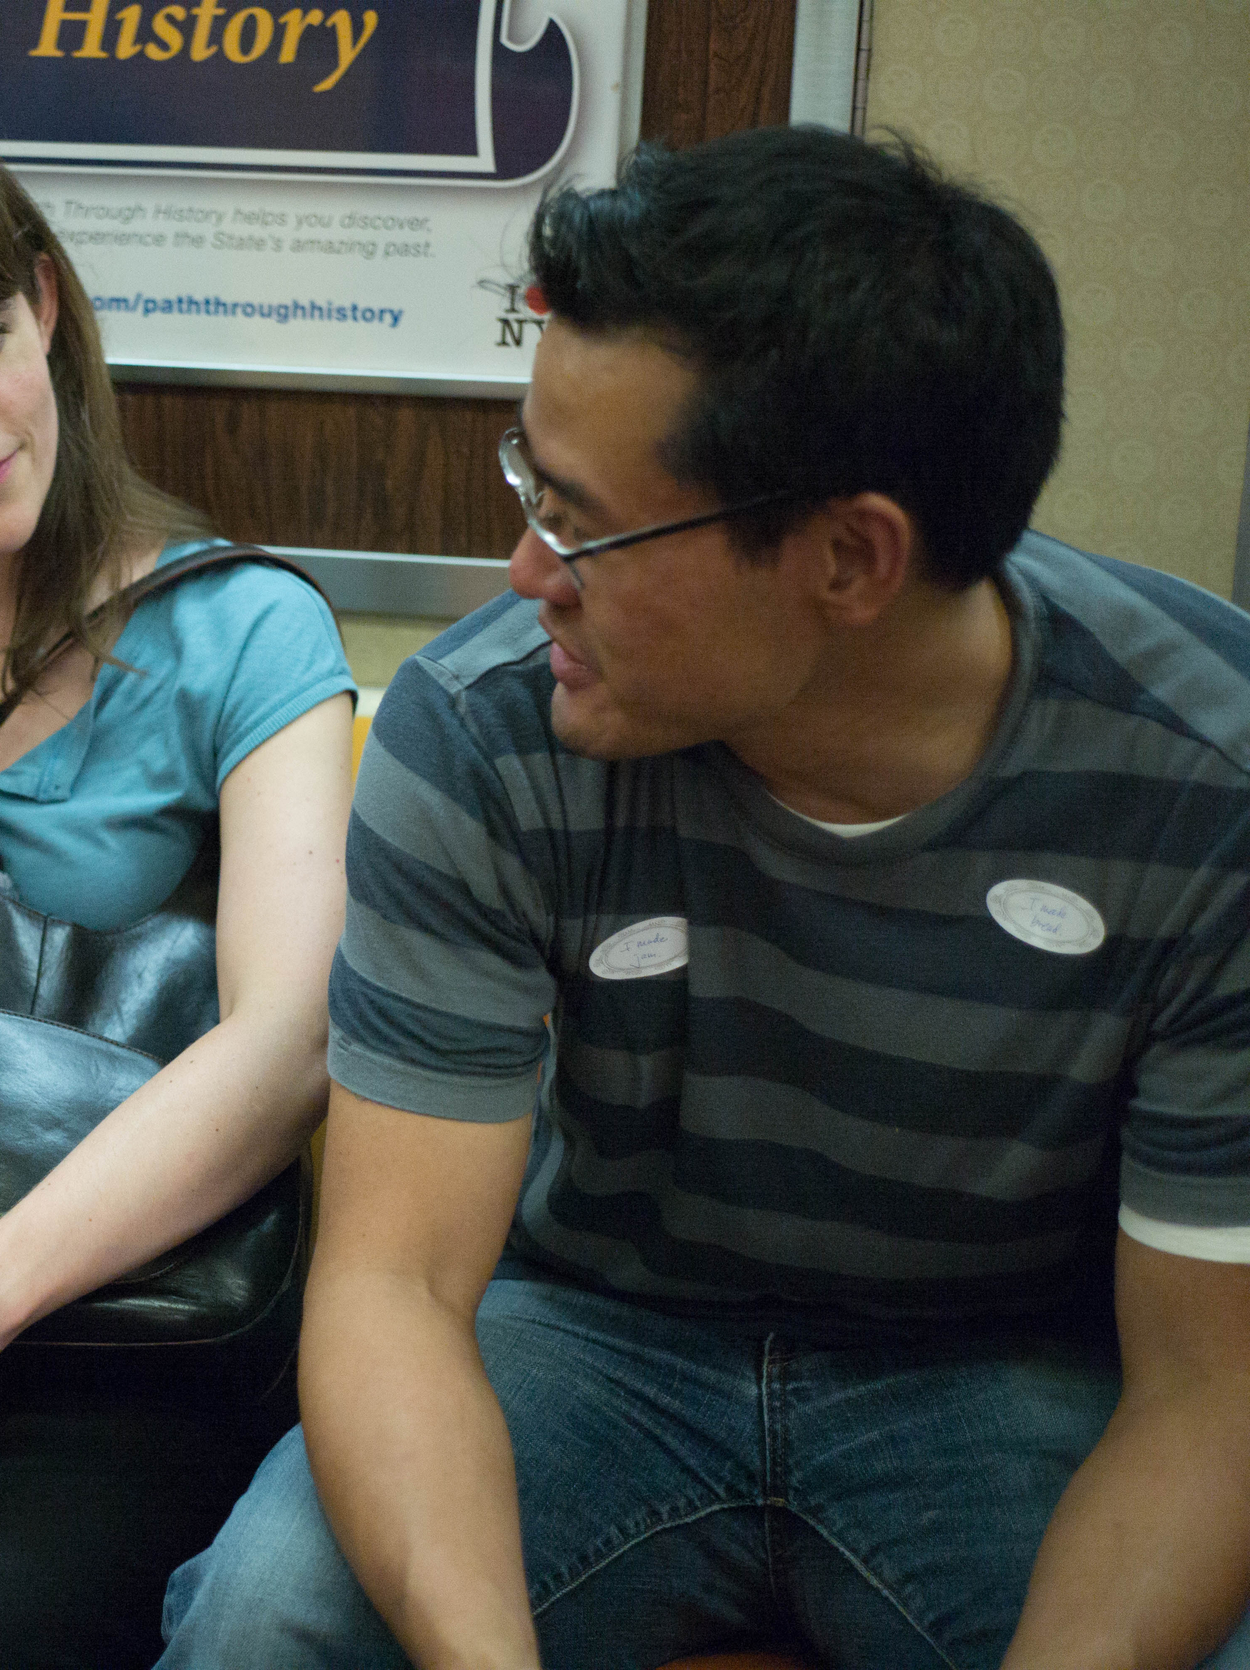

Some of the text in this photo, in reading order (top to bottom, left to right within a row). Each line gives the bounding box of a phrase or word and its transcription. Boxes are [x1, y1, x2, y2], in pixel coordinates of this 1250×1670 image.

[28, 0, 378, 92] History
[63, 200, 147, 225] Through
[151, 203, 225, 228] History
[232, 206, 287, 229] helps
[295, 212, 333, 231] you
[172, 231, 206, 248] the
[211, 231, 284, 253] State's
[289, 236, 378, 260] amazing
[91, 291, 403, 328] om/paththroughhistory
[504, 283, 520, 313] I
[637, 932, 668, 948] made
